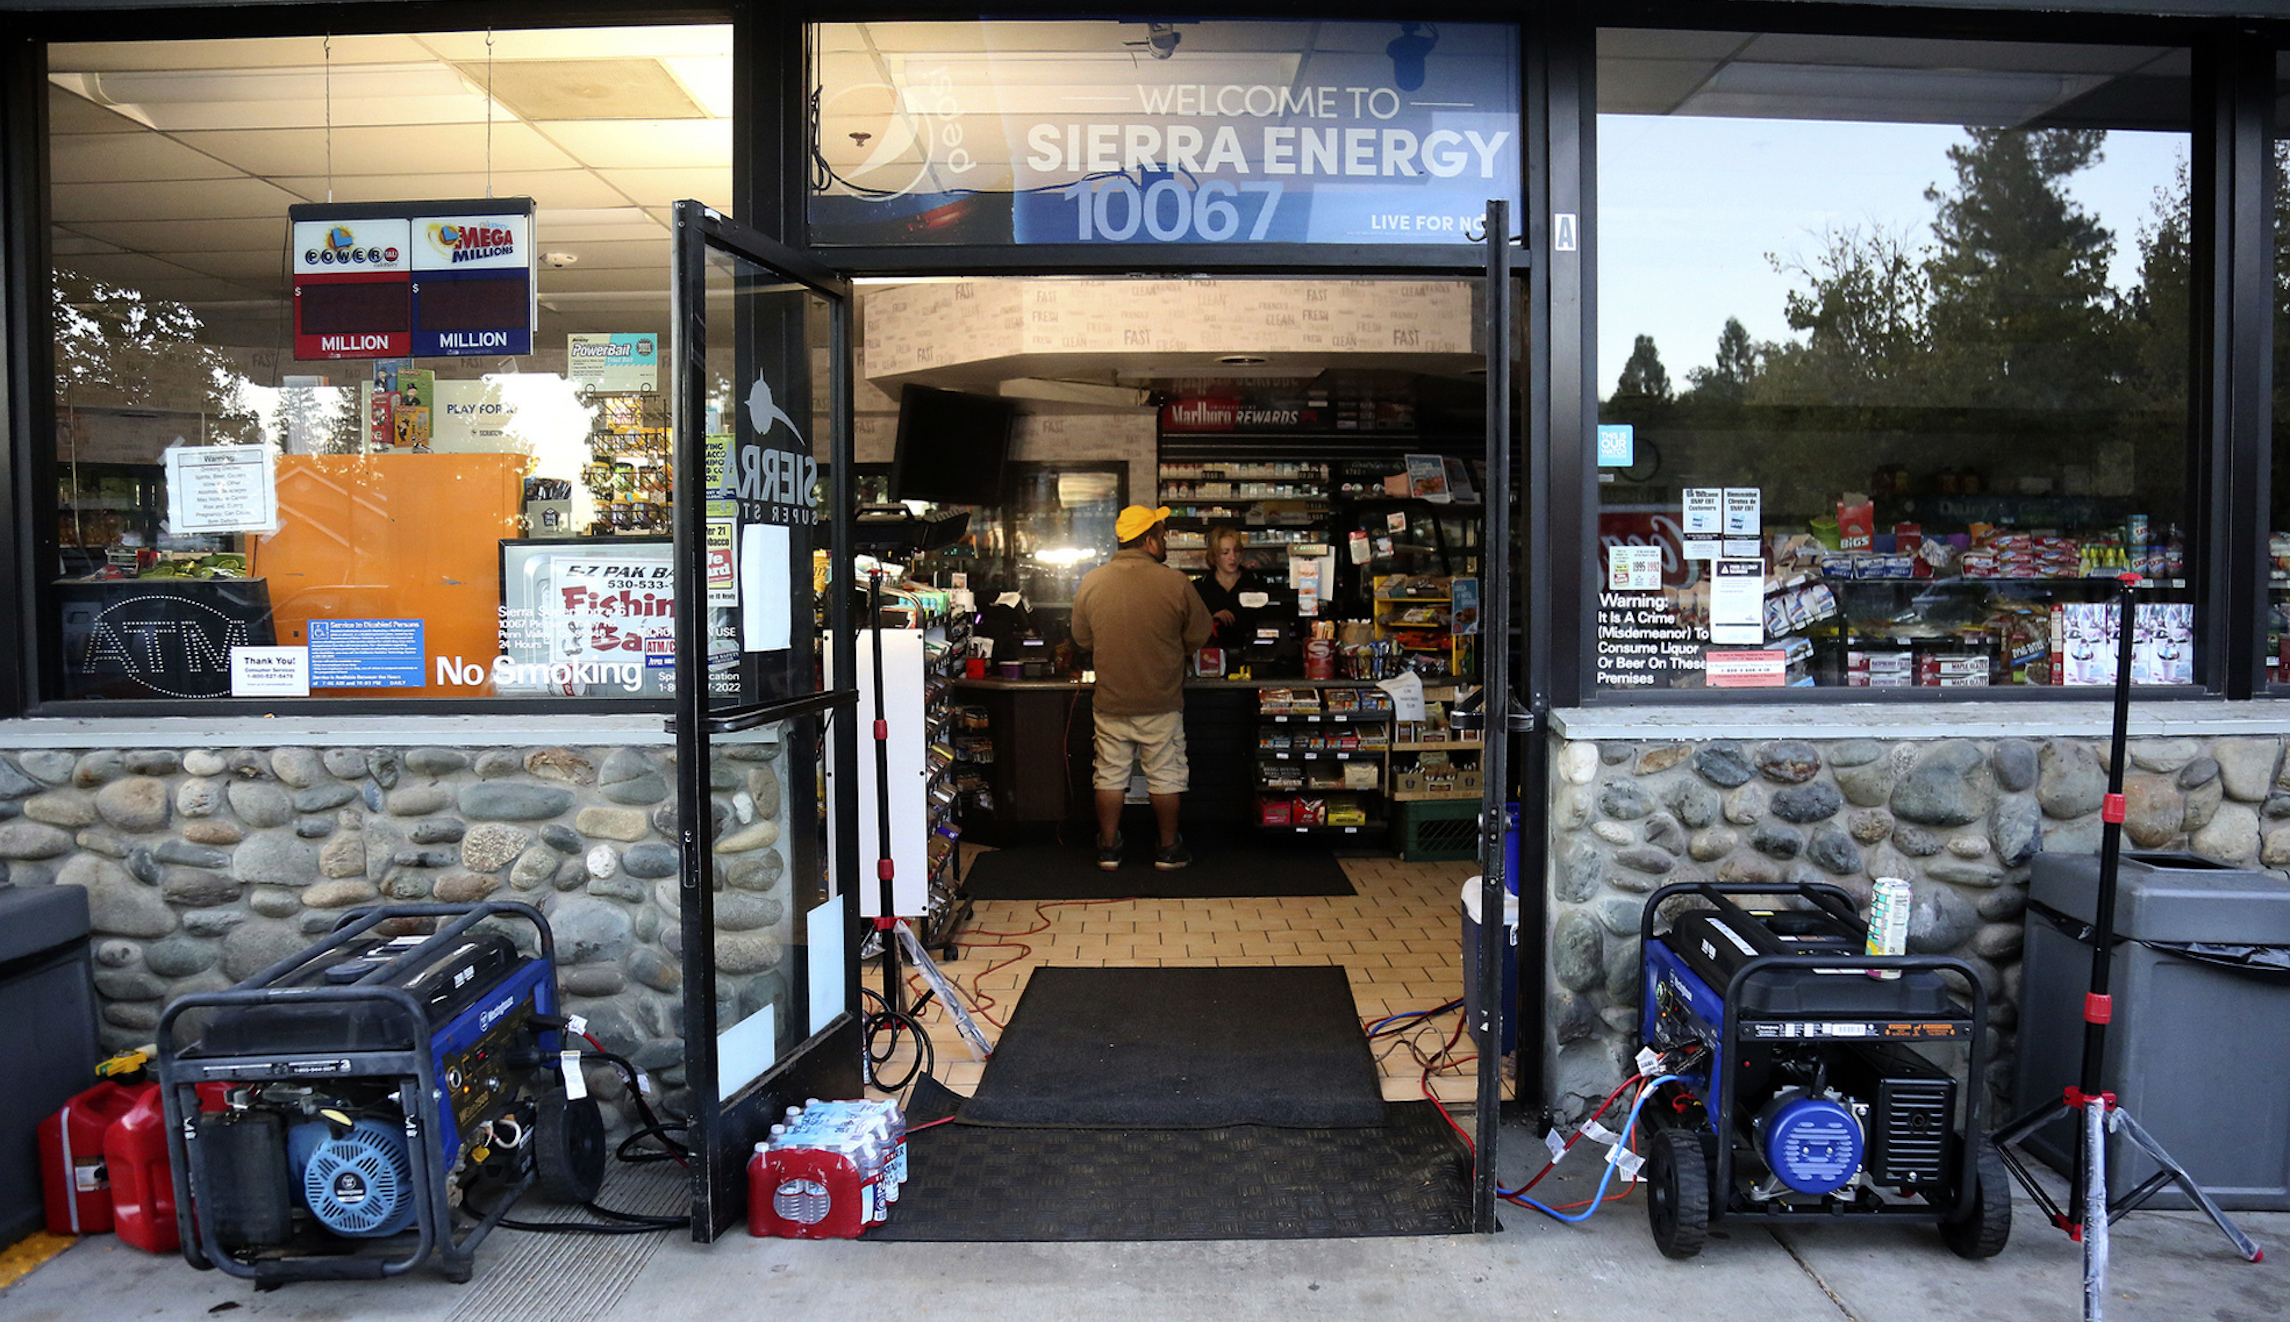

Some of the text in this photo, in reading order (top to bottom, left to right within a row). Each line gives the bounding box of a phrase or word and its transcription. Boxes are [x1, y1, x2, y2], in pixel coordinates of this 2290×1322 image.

[1137, 84, 1400, 121] WELCOME TO
[934, 69, 978, 175] pepsi
[1026, 122, 1510, 179] SIERRA ENERGY
[1063, 178, 1284, 242] 10067
[1371, 214, 1411, 230] LIVE
[1416, 215, 1454, 231] FOR
[454, 225, 513, 250] MEGA
[1558, 217, 1575, 249] A
[452, 246, 514, 264] MILLIONS
[294, 286, 302, 297] $
[412, 283, 420, 294] $
[955, 283, 974, 301] FAST
[1307, 289, 1328, 301] FAST
[1036, 290, 1057, 302] FAST
[1032, 311, 1058, 323] FRESH
[1266, 314, 1295, 326] CLEAN
[1302, 310, 1328, 322] FRESH
[321, 335, 389, 351] MILLION
[440, 332, 507, 348] MILLION
[1124, 329, 1151, 345] FAST
[1333, 336, 1357, 347] CLEAN
[1393, 330, 1420, 346] FAST
[571, 343, 632, 358] PowerBait
[917, 346, 934, 362] FAST
[447, 404, 503, 415] PLAY FOR
[1171, 401, 1299, 425] Marlboro REWARDS
[1601, 432, 1627, 440] THIS IS
[1601, 440, 1627, 450] OUR
[717, 526, 726, 535] 21
[566, 565, 601, 577] E-Z
[602, 565, 646, 578] PAK
[1599, 593, 1669, 611] Warning:
[497, 606, 534, 618] Sierra
[1597, 611, 1676, 624] It Is A Crime
[330, 621, 420, 629] Service to Disabled Persons
[498, 619, 526, 629] 10067
[498, 630, 523, 639] Penn
[715, 627, 737, 637] USE
[1597, 626, 1710, 641] (Misdemeanor) To
[81, 619, 249, 674] ATM
[498, 640, 542, 649] 24 Hours
[1597, 641, 1699, 656] Consume Liquor
[244, 656, 297, 666] Thank You!
[1597, 657, 1614, 670] Or
[1616, 657, 1648, 670] Beer
[1649, 657, 1667, 670] On
[435, 656, 485, 686] No
[491, 654, 643, 693] Smoking
[1597, 671, 1655, 685] Premises
